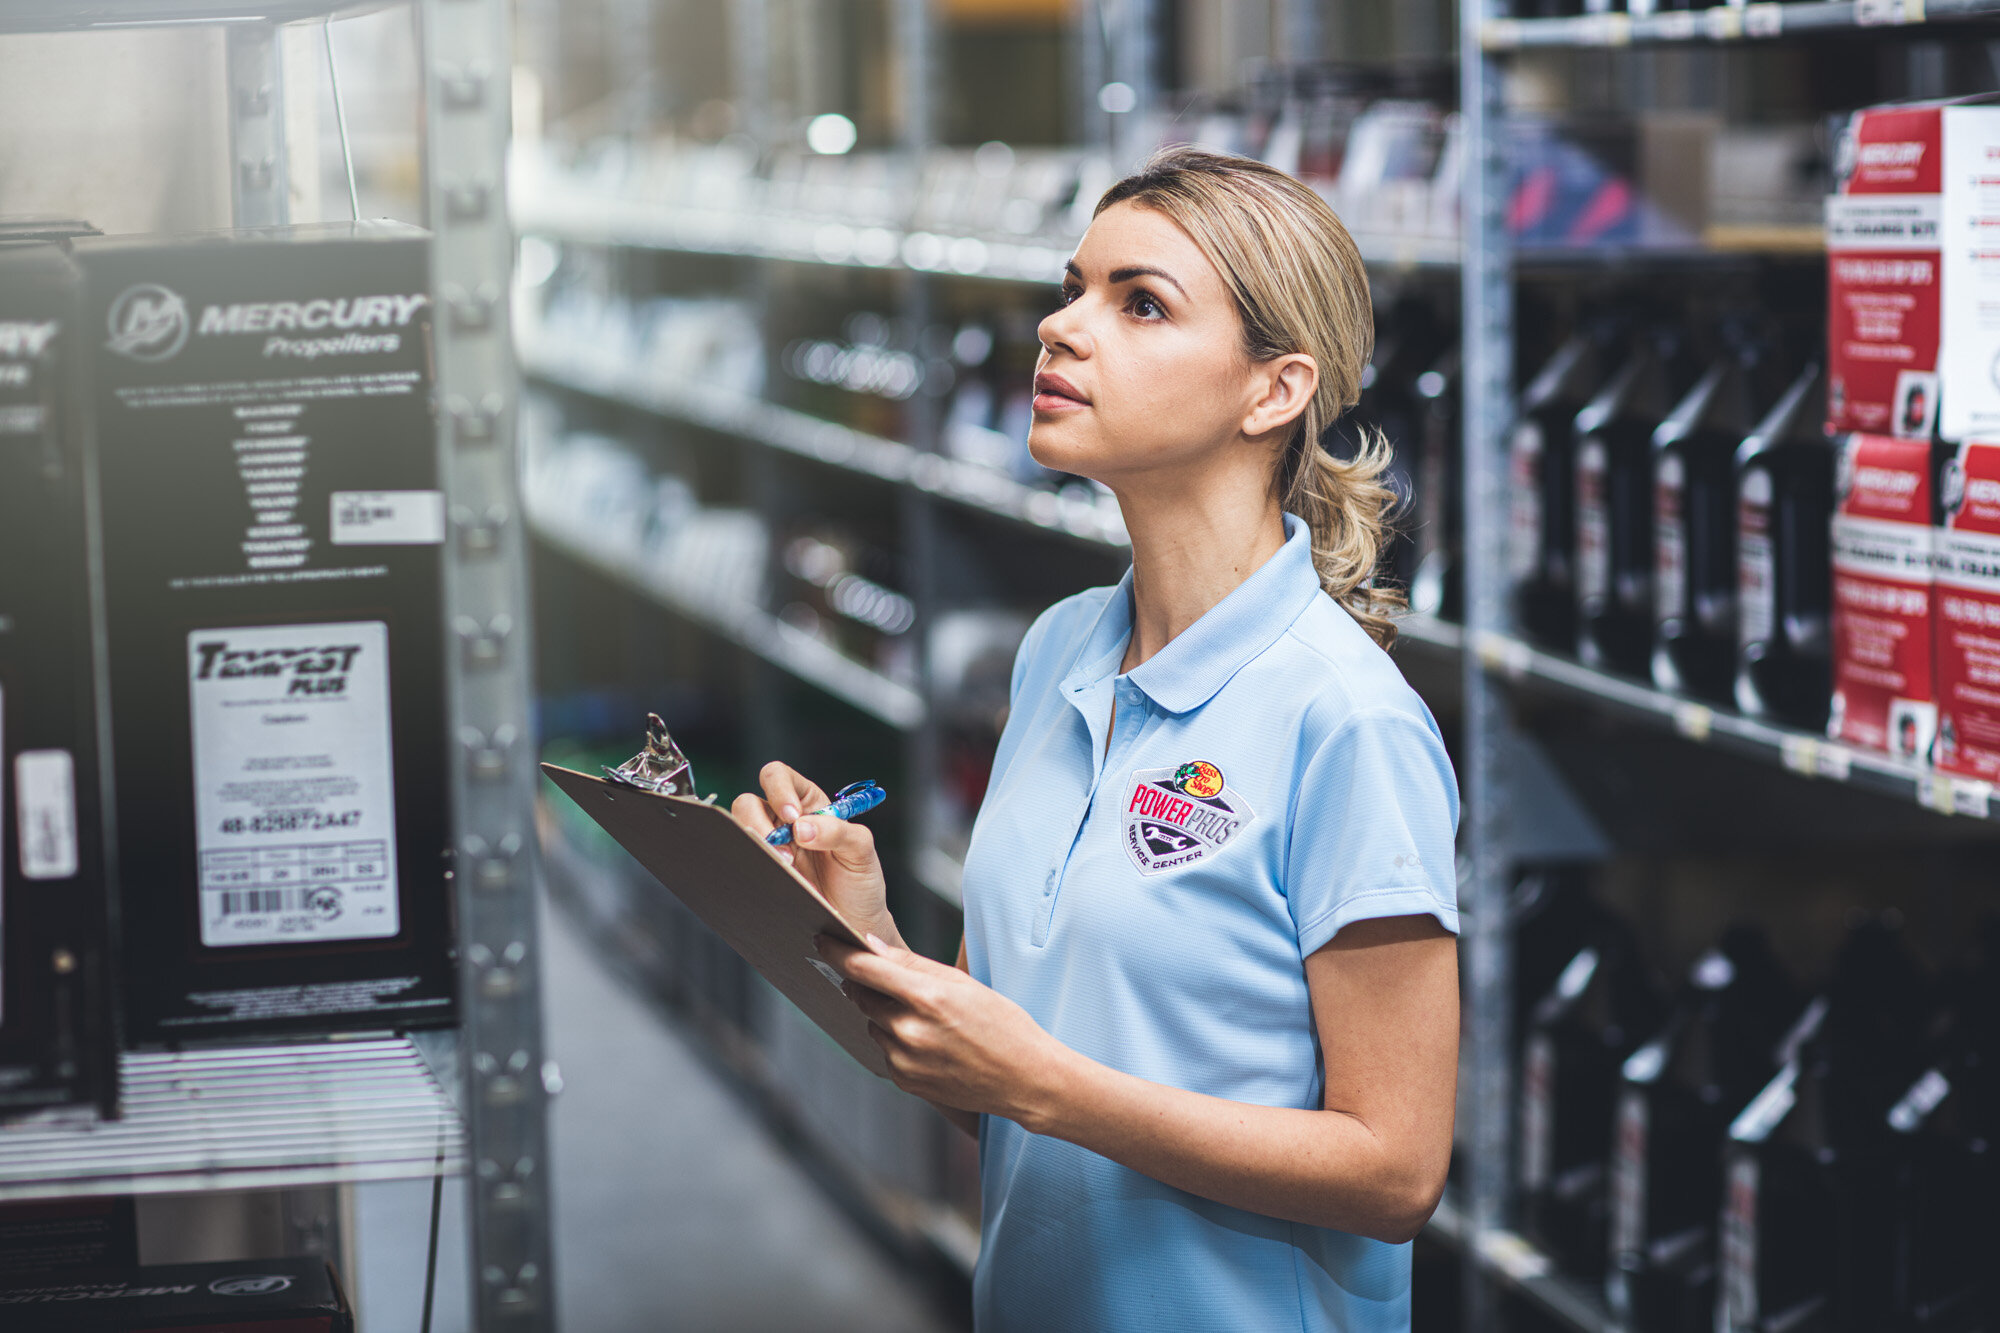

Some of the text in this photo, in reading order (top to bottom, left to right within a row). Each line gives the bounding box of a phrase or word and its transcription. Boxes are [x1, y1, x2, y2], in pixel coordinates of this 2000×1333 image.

[199, 294, 428, 335] MERCURY
[262, 333, 401, 359] Propellers
[196, 641, 361, 679] TEMPEST
[288, 676, 346, 695] PLUS
[1195, 774, 1210, 784] Pro
[1199, 763, 1218, 779] Bass
[1190, 781, 1216, 796] Shops
[1128, 824, 1203, 869] SERVICE CENTER
